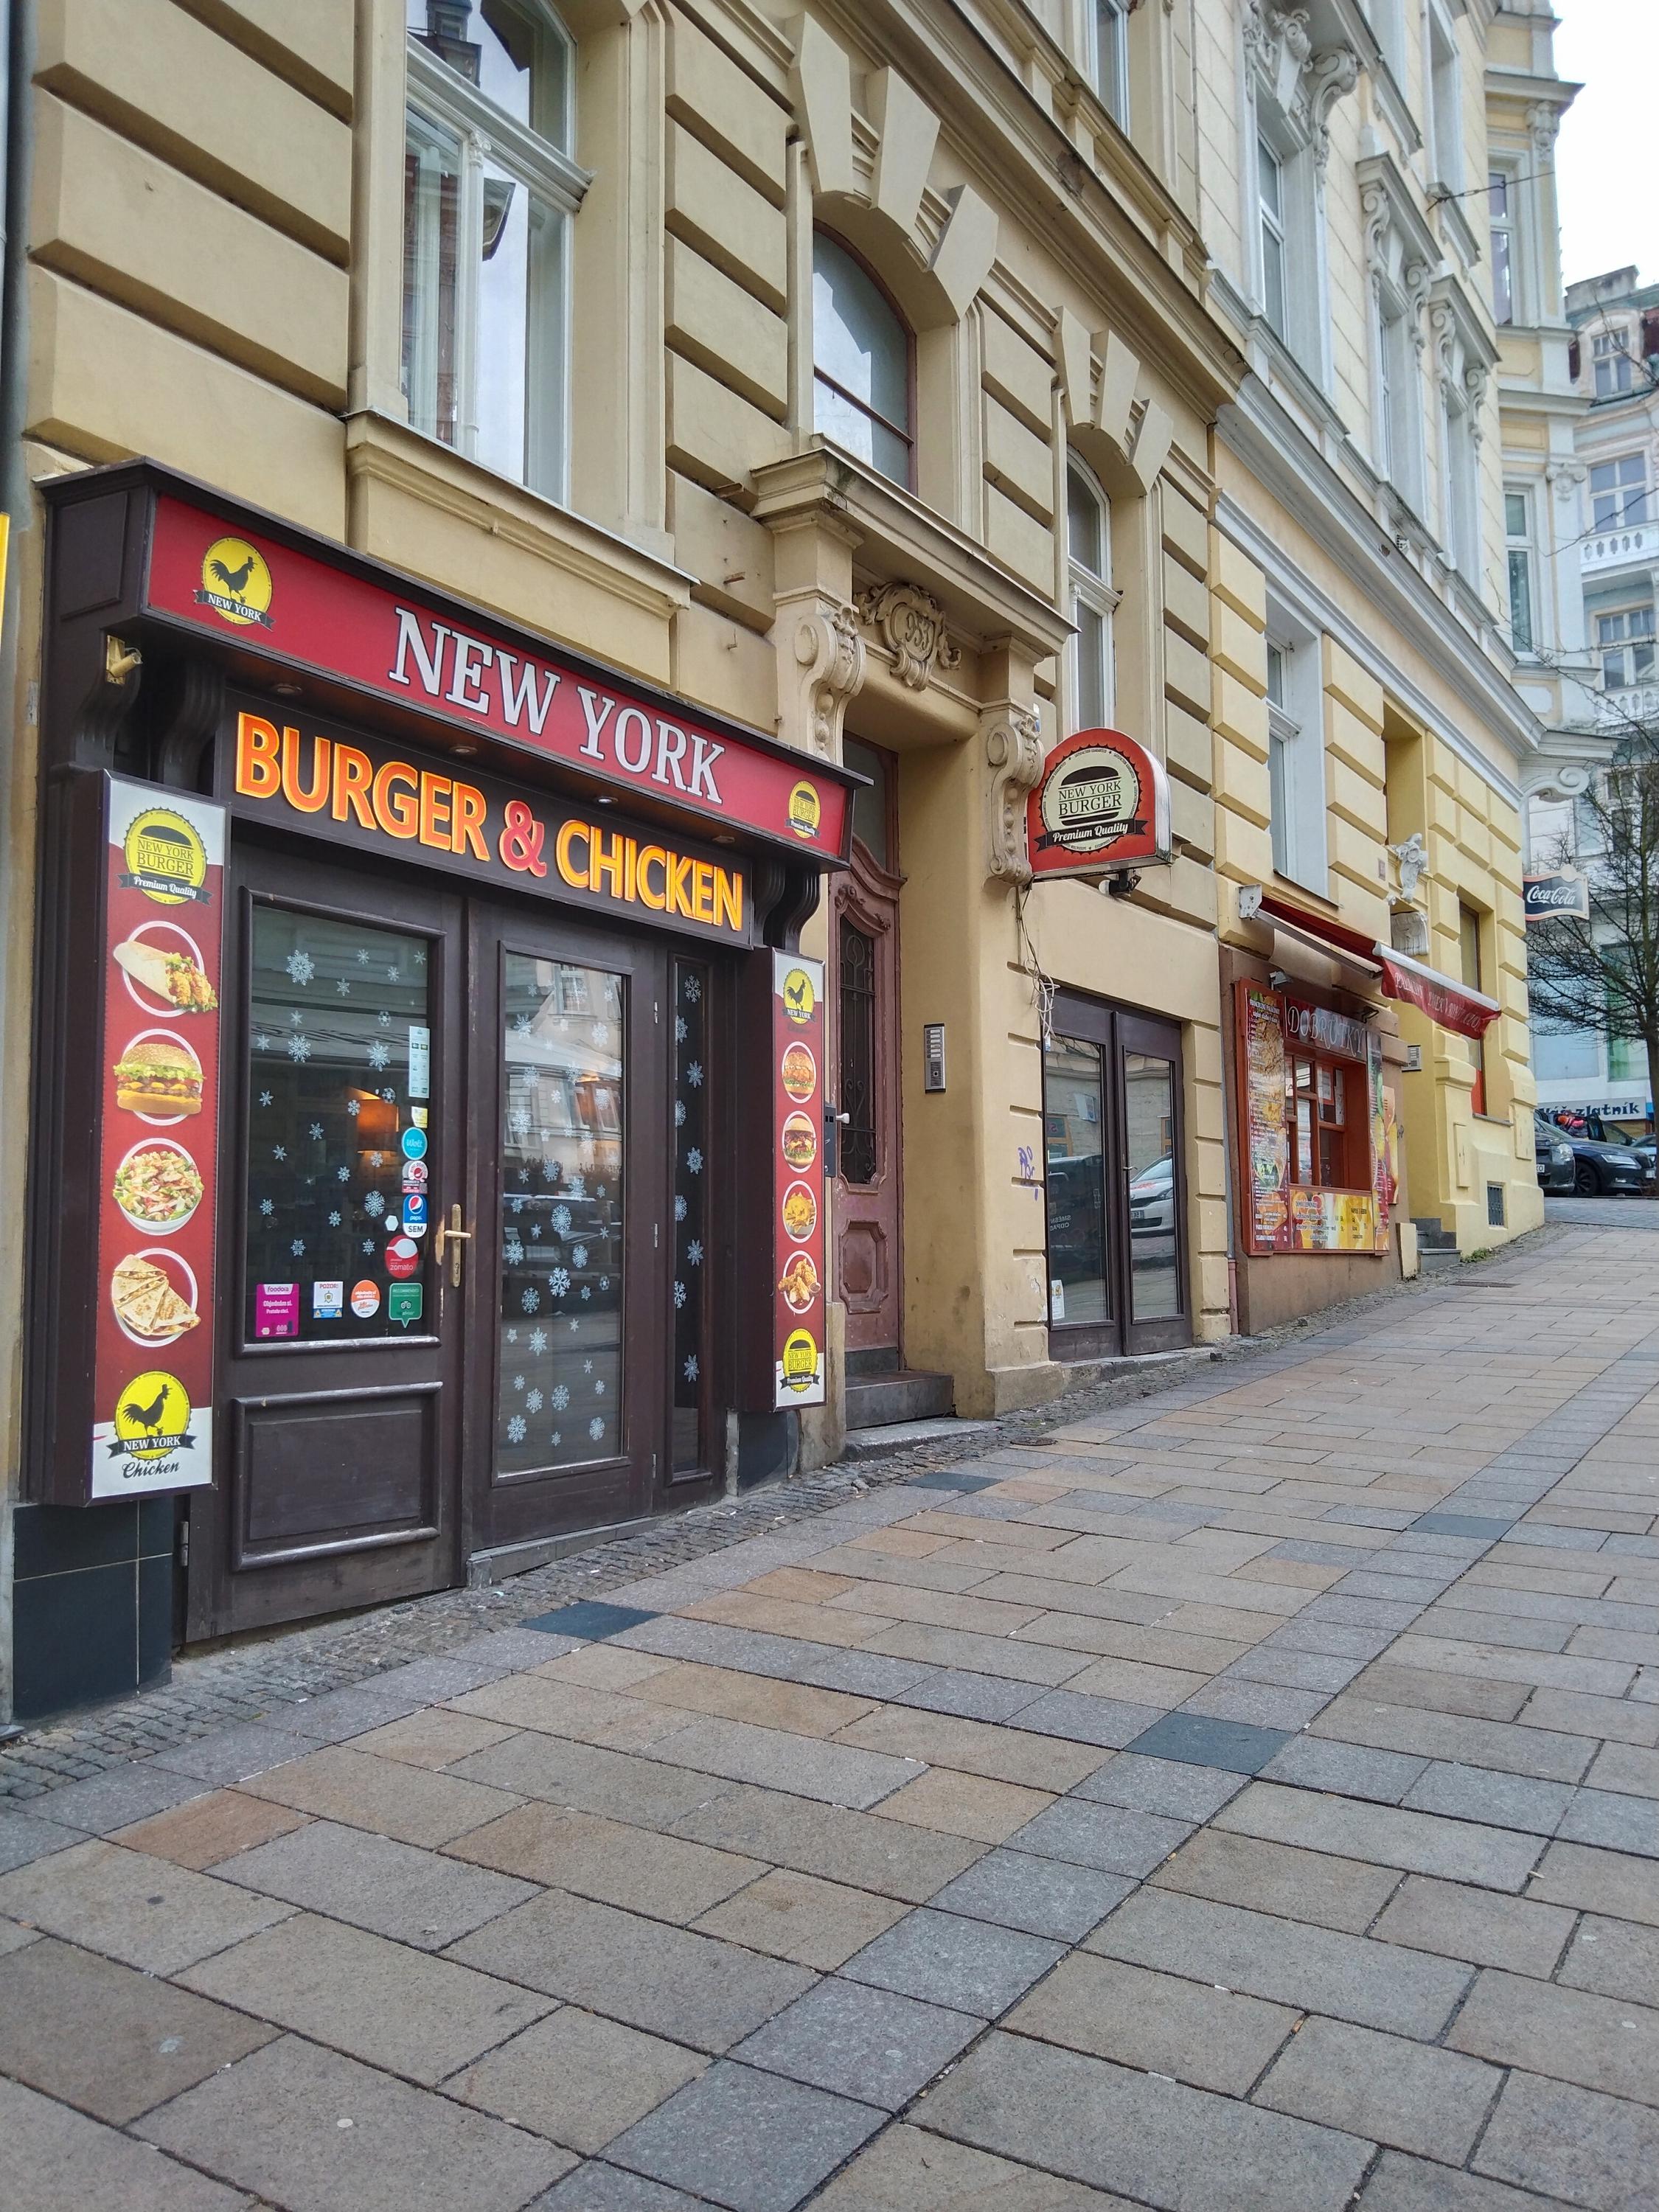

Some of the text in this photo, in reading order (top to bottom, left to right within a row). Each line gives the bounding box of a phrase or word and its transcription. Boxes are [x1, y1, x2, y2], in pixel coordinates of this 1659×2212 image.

[208, 594, 262, 622] NEW YORK
[389, 606, 726, 805] NEW YORK
[1058, 780, 1121, 801] NEW YORK
[793, 806, 815, 821] BURGER
[1058, 793, 1122, 815] BURGER
[236, 712, 743, 931] BURGER & CHICKEN
[1052, 823, 1129, 843] Premium Quality
[137, 838, 194, 860] NEW YORK
[137, 852, 194, 875] BURGER
[133, 875, 197, 899] Premium Quality
[1526, 885, 1577, 905] Coca-Cola
[787, 1009, 811, 1019] NEW YORK
[1576, 1102, 1639, 1116] zlatník
[787, 1350, 812, 1360] NEW YORK
[787, 1359, 813, 1369] BURGER
[123, 1436, 181, 1452] NEW YORK
[122, 1460, 181, 1479] Chicken
